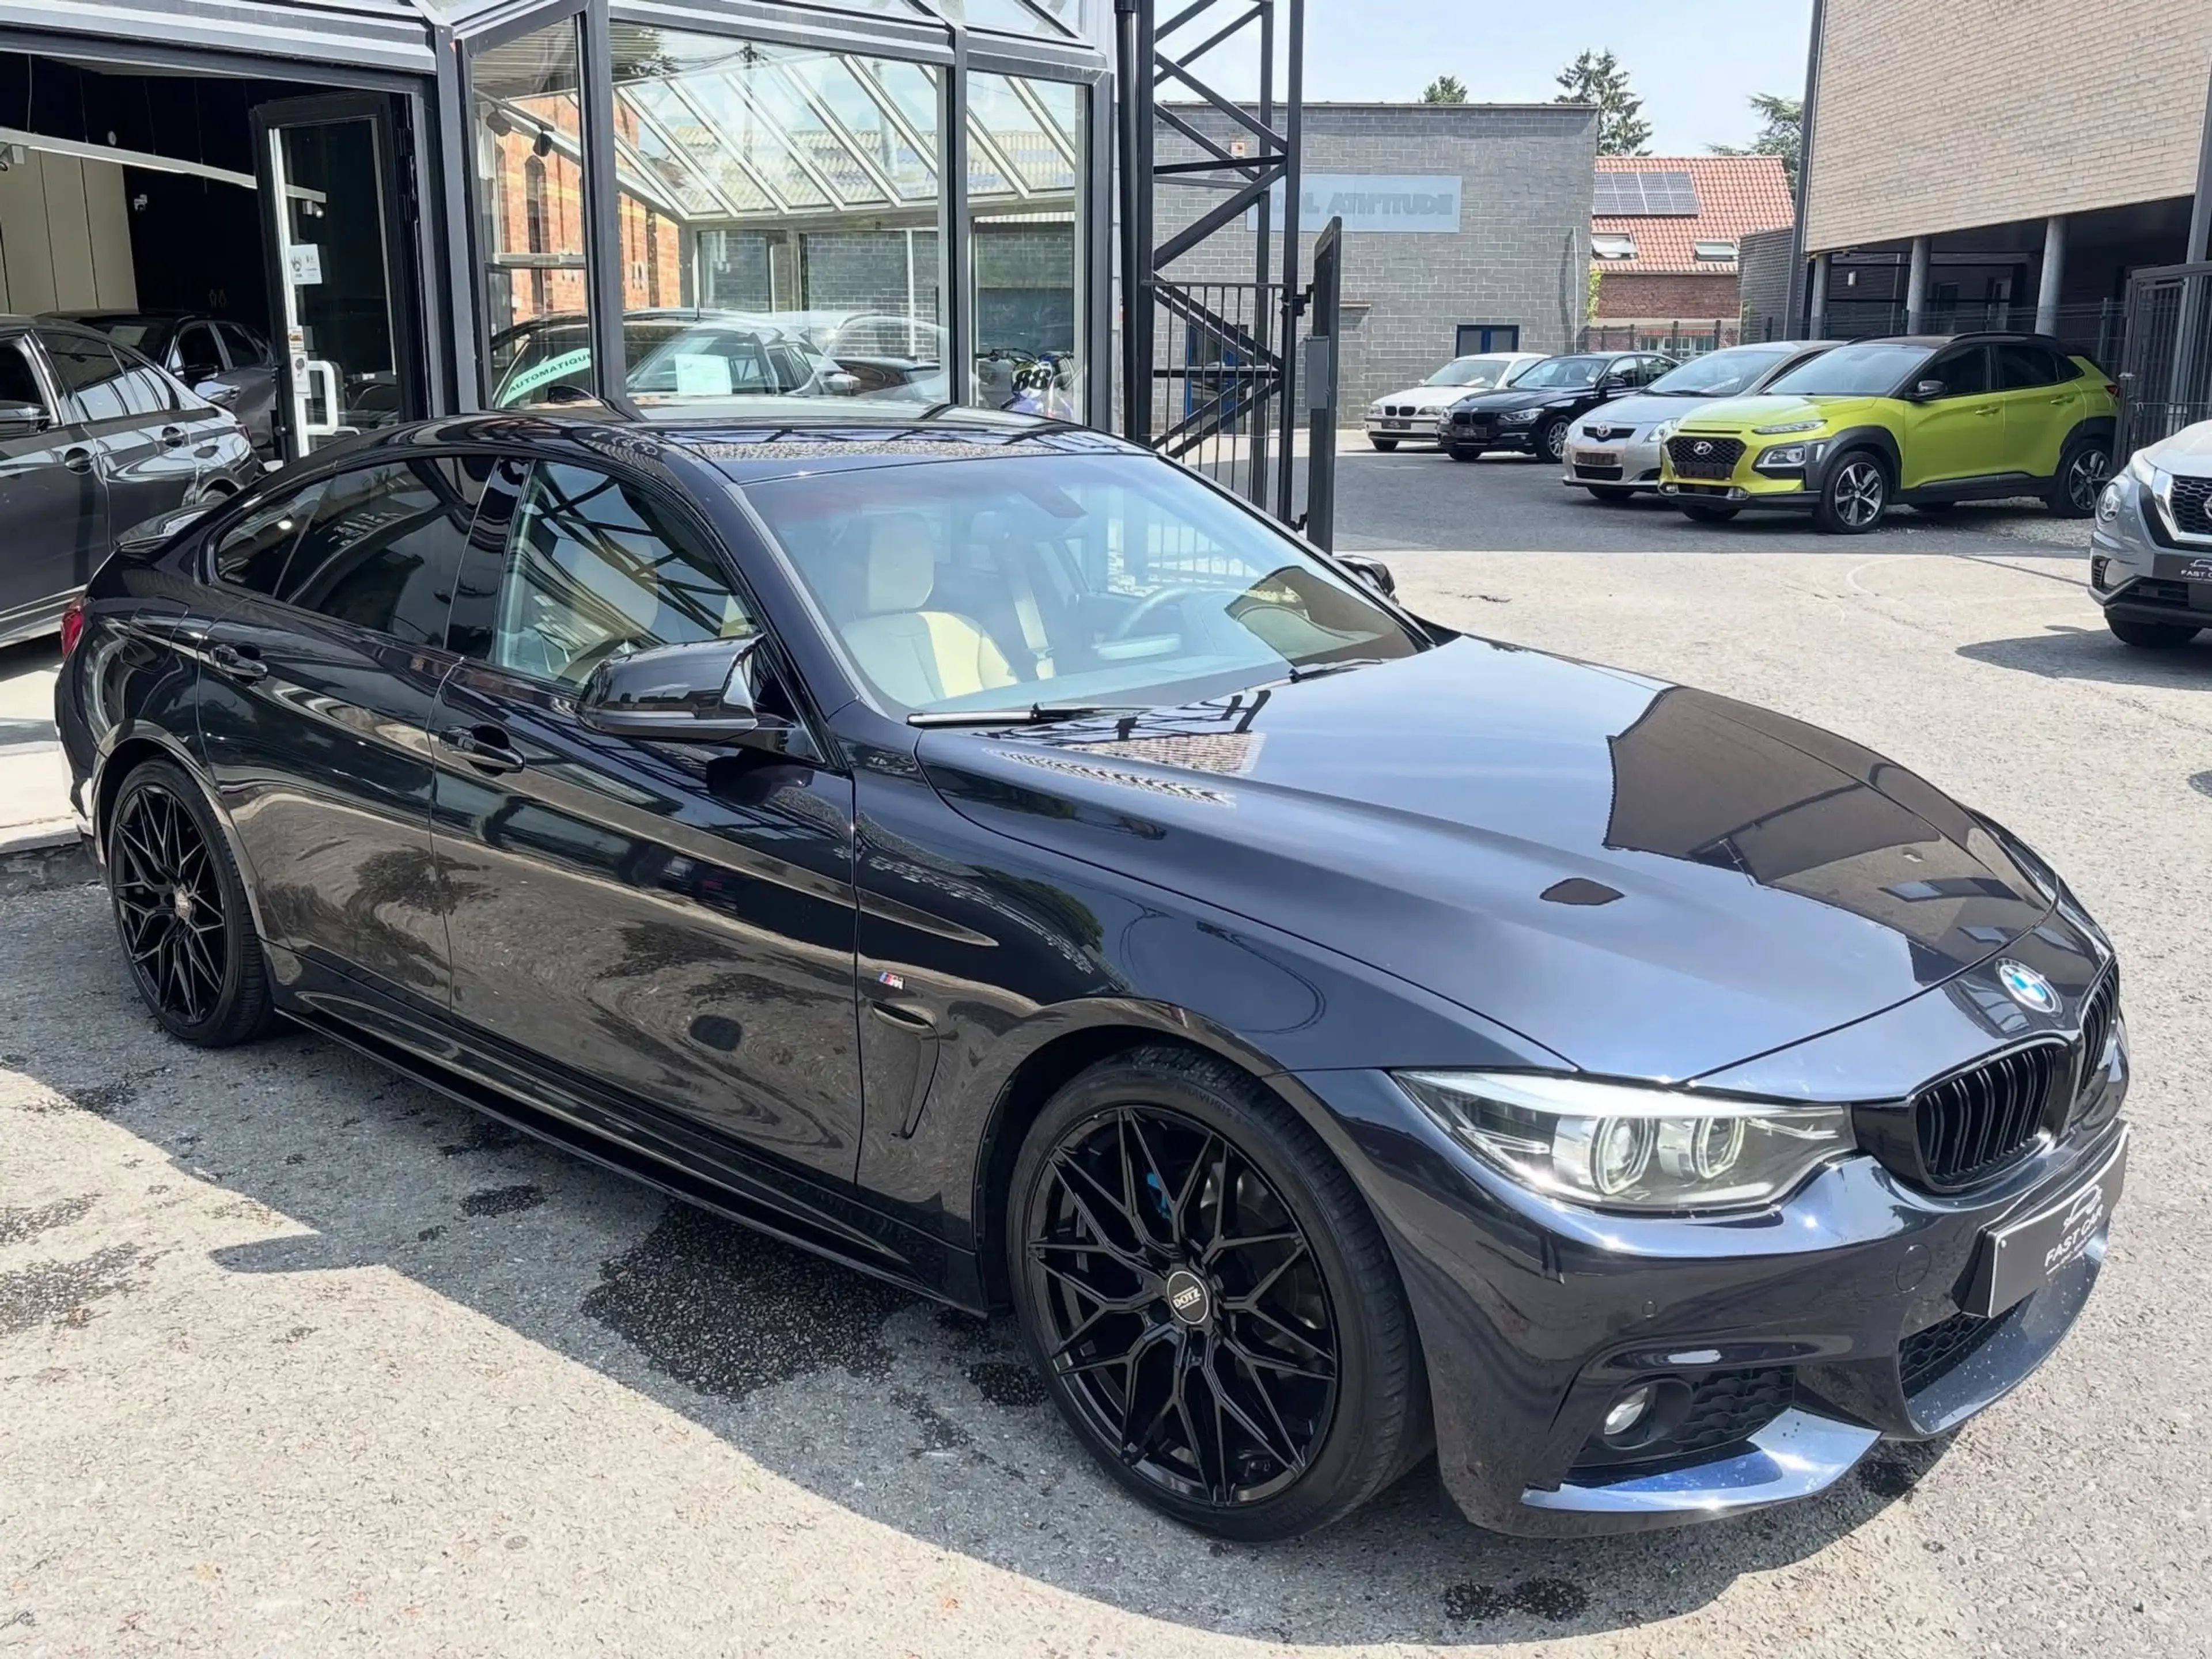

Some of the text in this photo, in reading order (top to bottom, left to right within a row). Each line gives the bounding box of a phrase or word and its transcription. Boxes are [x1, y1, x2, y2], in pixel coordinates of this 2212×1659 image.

[509, 353, 590, 393] AUTOMATIQU
[2044, 1228, 2080, 1267] FAST
[1173, 1287, 1201, 1308] DOTZ
